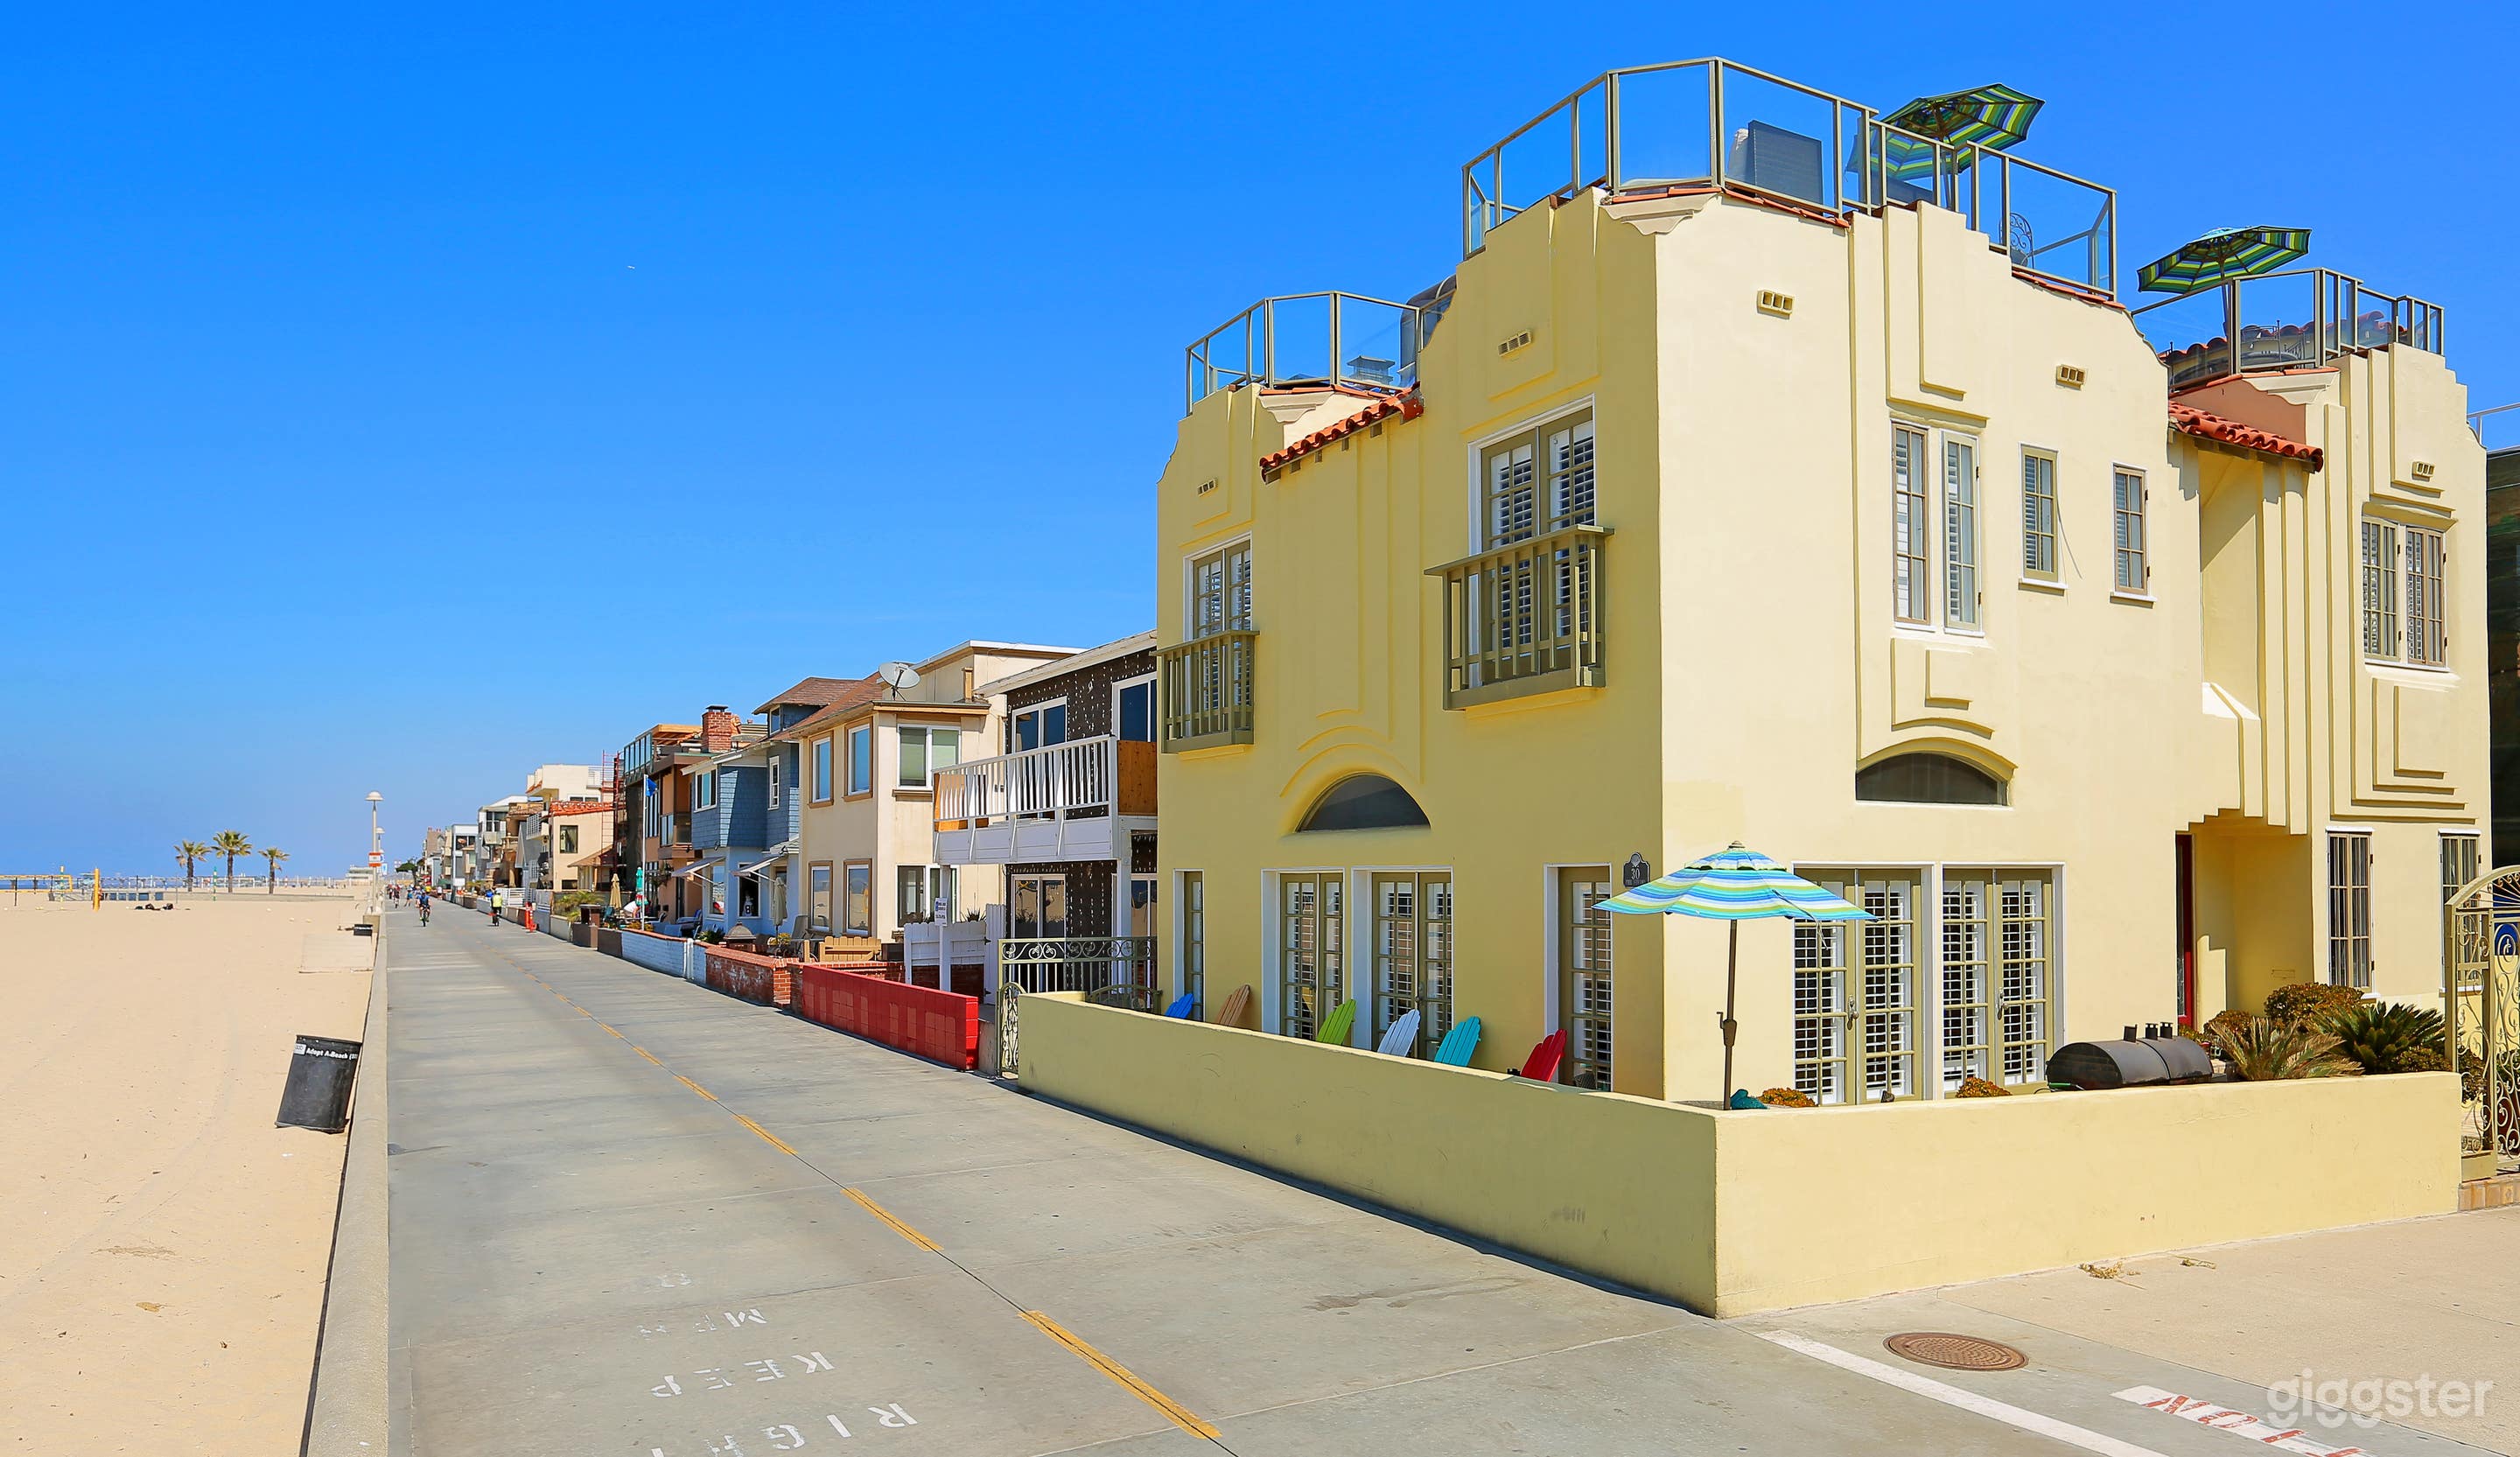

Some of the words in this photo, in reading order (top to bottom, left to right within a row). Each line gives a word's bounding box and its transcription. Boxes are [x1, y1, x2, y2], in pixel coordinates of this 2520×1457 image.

[1631, 868, 1641, 879] 30
[306, 1047, 324, 1057] Adopt
[650, 1352, 835, 1397] KEEP
